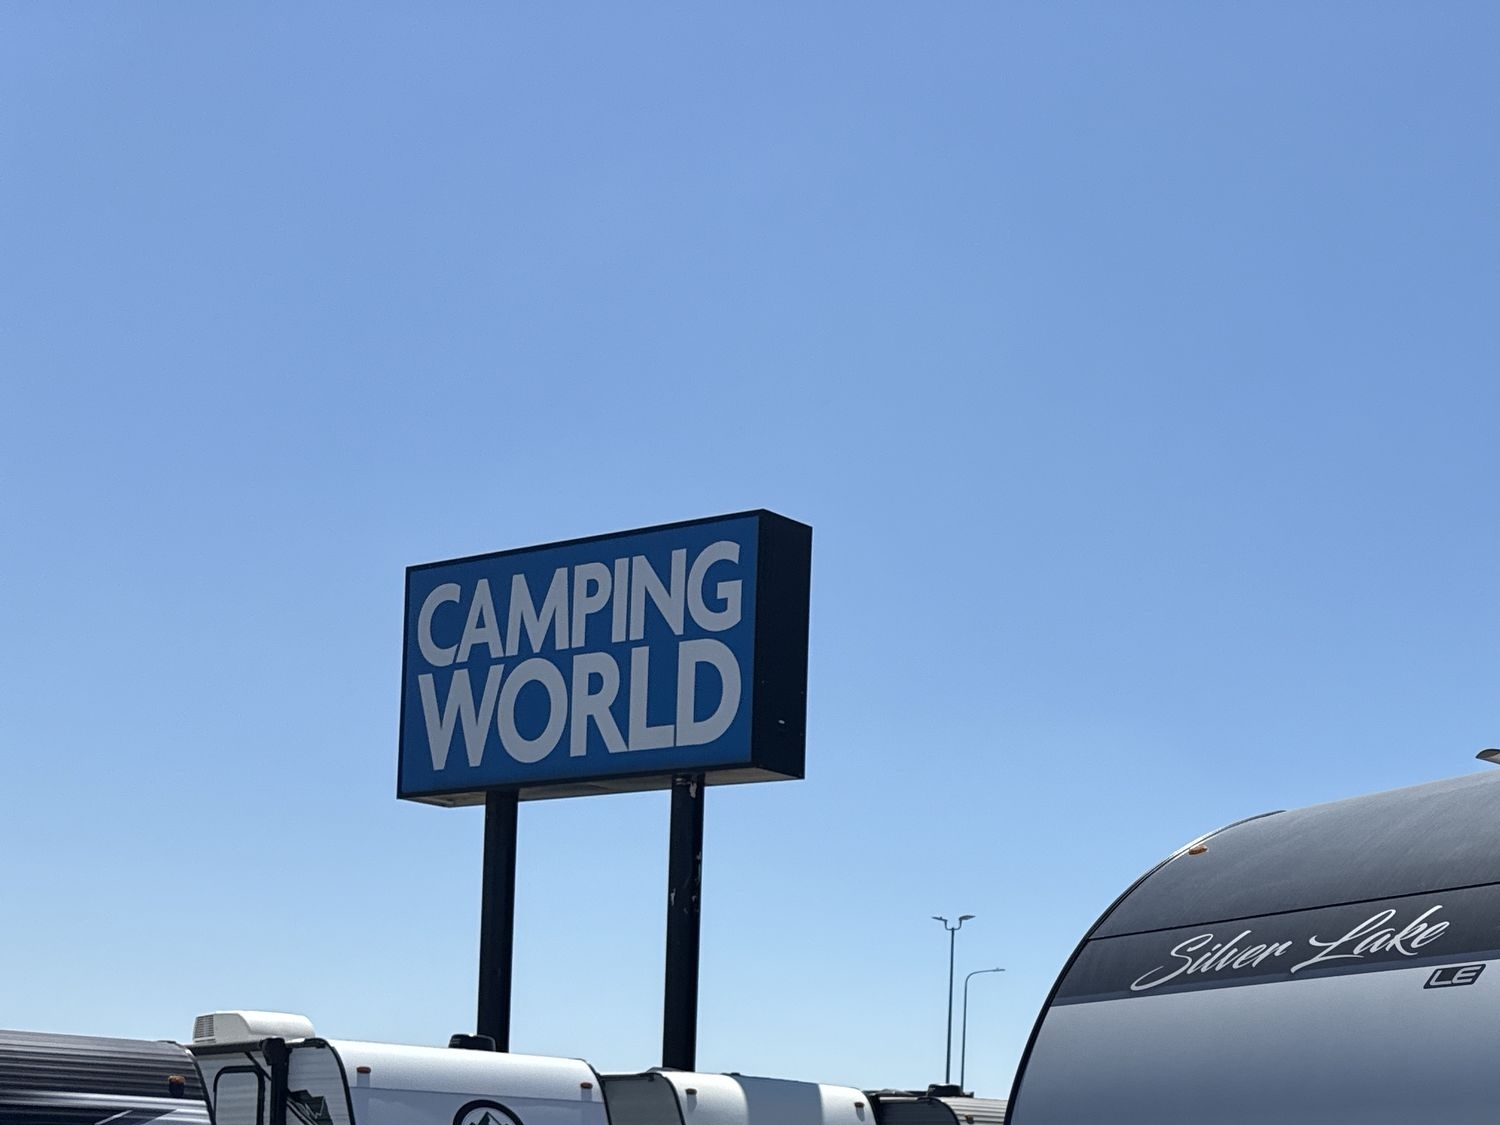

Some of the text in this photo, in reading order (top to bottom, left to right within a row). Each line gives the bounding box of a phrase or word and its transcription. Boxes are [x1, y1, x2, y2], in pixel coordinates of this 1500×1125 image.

[417, 540, 744, 667] CAMPING
[417, 638, 743, 771] WORLD
[1130, 905, 1450, 991] Silver Lake
[1428, 965, 1483, 987] LE
